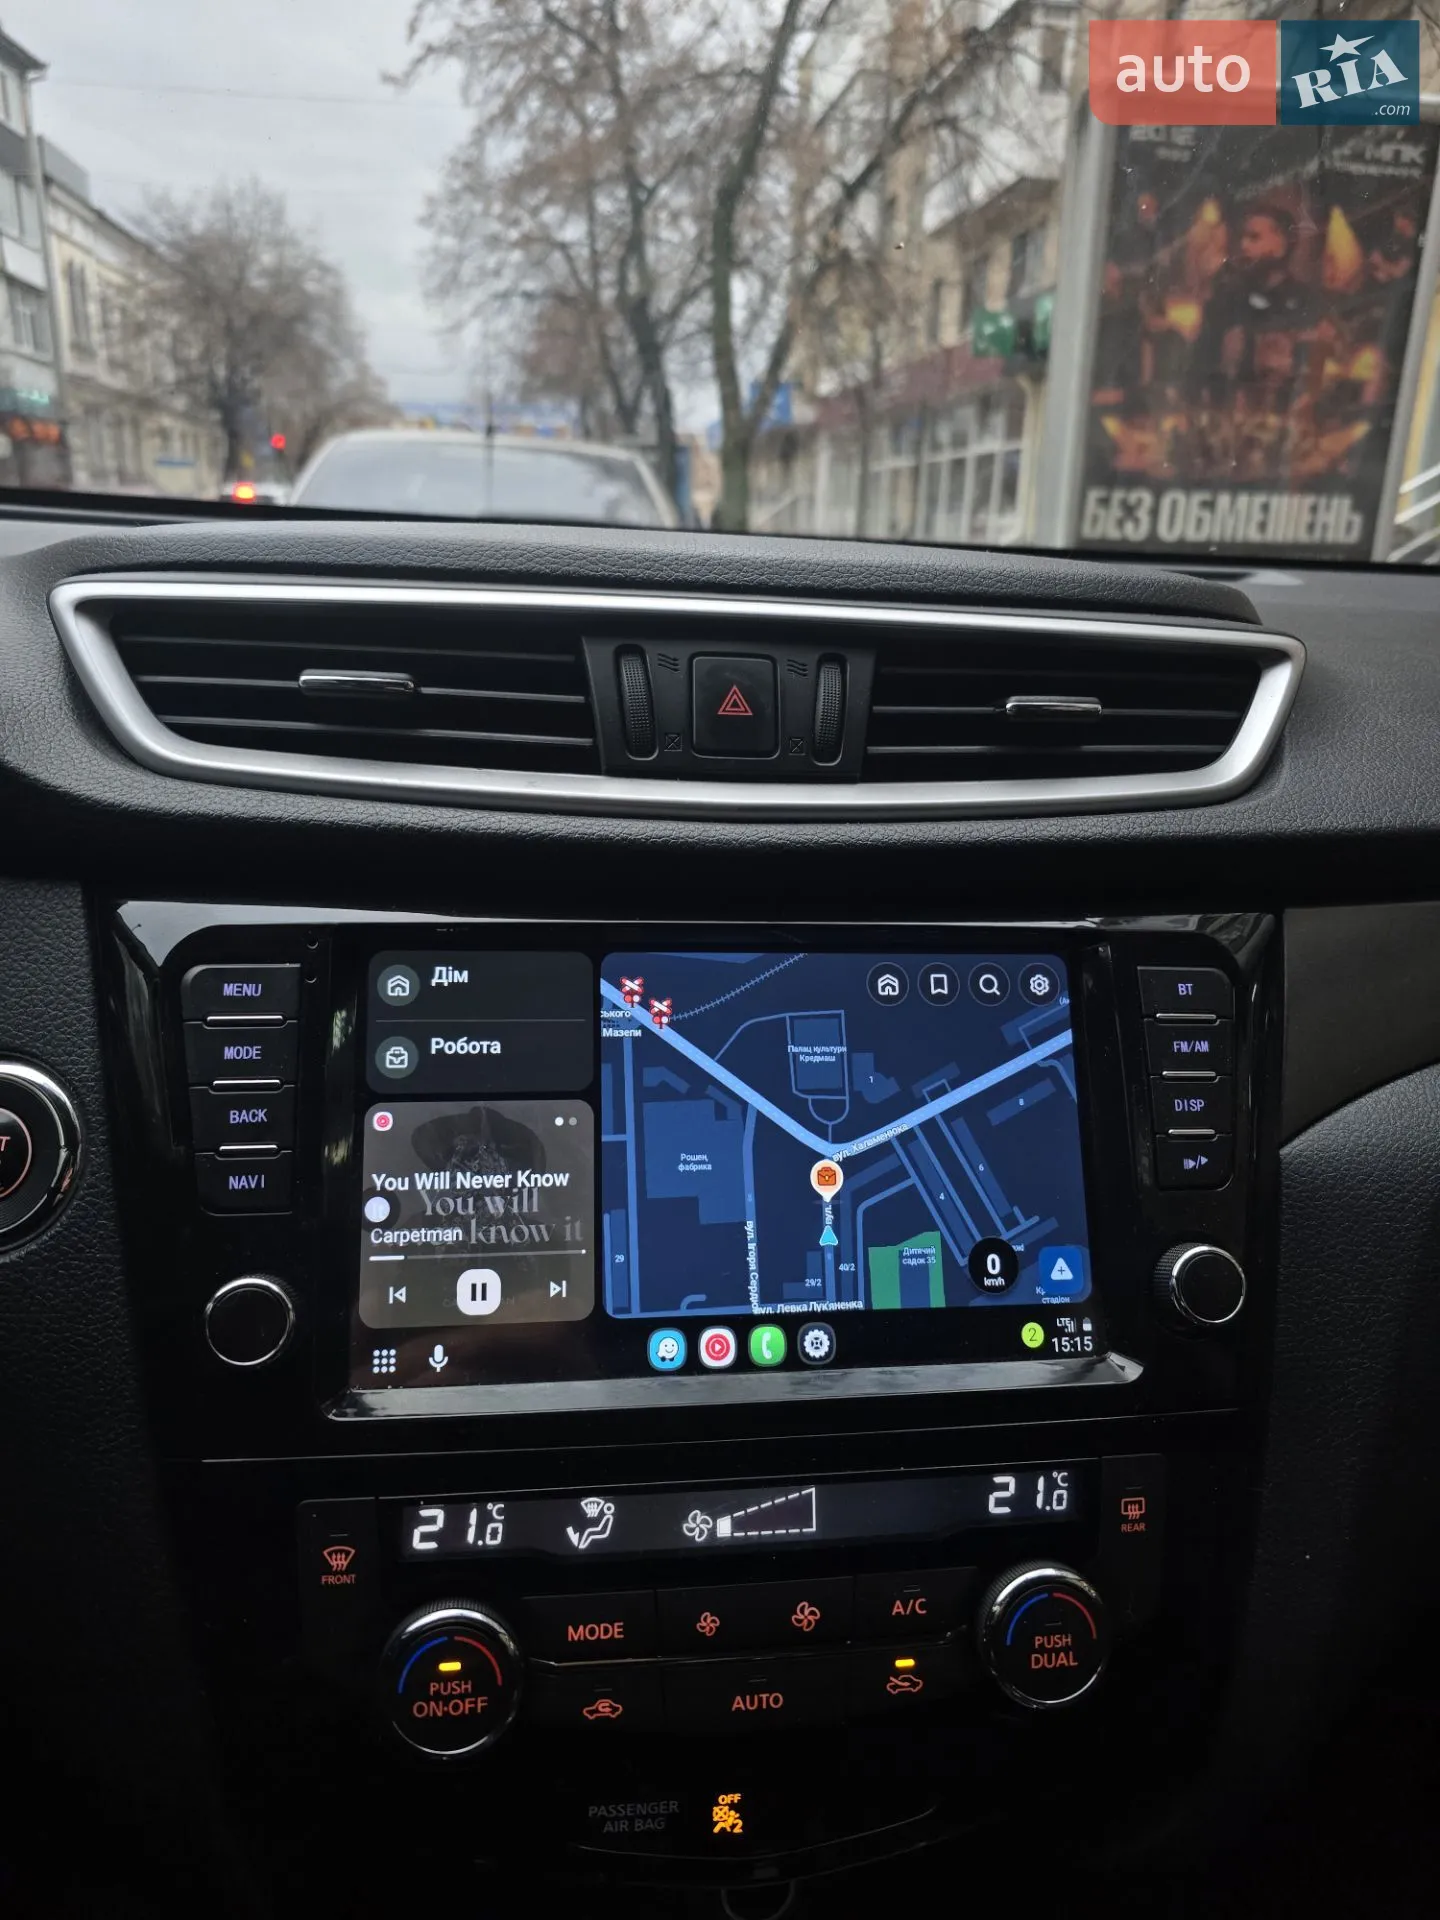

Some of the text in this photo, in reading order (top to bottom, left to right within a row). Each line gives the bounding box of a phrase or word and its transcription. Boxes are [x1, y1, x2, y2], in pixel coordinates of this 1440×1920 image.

[1081, 487, 1154, 542] БЕЗ
[431, 966, 469, 987] Дім
[223, 983, 262, 997] MENU
[1178, 983, 1193, 996] BT
[602, 1028, 642, 1038] Мазепи
[224, 1046, 262, 1060] MODE
[431, 1037, 502, 1055] Робота
[788, 1045, 847, 1054] Палац культури
[1173, 1040, 1209, 1053] FM/AM
[799, 1054, 836, 1063] Кредмаш
[869, 1075, 874, 1083] 1
[1174, 1099, 1205, 1112] DISP
[229, 1108, 268, 1124] BACK
[832, 1149, 851, 1163] вул.
[678, 1163, 712, 1173] фабрика
[978, 1163, 985, 1172] 6
[228, 1175, 265, 1190] NAVI
[371, 1170, 570, 1191] You Will Never Know
[420, 1187, 539, 1216] You will
[939, 1192, 945, 1200] 4
[370, 1227, 463, 1247] Carpetman
[470, 1216, 585, 1245] know it
[745, 1220, 755, 1241] вул.
[615, 1254, 625, 1263] 29
[747, 1243, 757, 1270] Ігоря
[902, 1246, 936, 1257] Дитячий
[839, 1263, 856, 1272] 40/2
[902, 1256, 936, 1266] садок 35
[986, 1253, 1001, 1275] 0
[805, 1278, 822, 1287] 29/2
[984, 1277, 1005, 1287] km/h
[776, 1303, 808, 1314] Левка
[1057, 1317, 1070, 1327] LTE
[1028, 1327, 1038, 1342] 2
[1052, 1335, 1093, 1352] 15:15
[1121, 1523, 1146, 1533] REAR
[321, 1573, 356, 1586] FRONT
[891, 1598, 927, 1616] A/C
[567, 1622, 625, 1642] MODE
[1034, 1634, 1072, 1649] PUSH
[1031, 1651, 1079, 1669] DUAL
[430, 1680, 472, 1697] PUSH
[731, 1693, 783, 1712] AUTO
[718, 1793, 742, 1805] OFF
[588, 1801, 680, 1818] PASSENGER
[603, 1817, 666, 1833] AIR BAG
